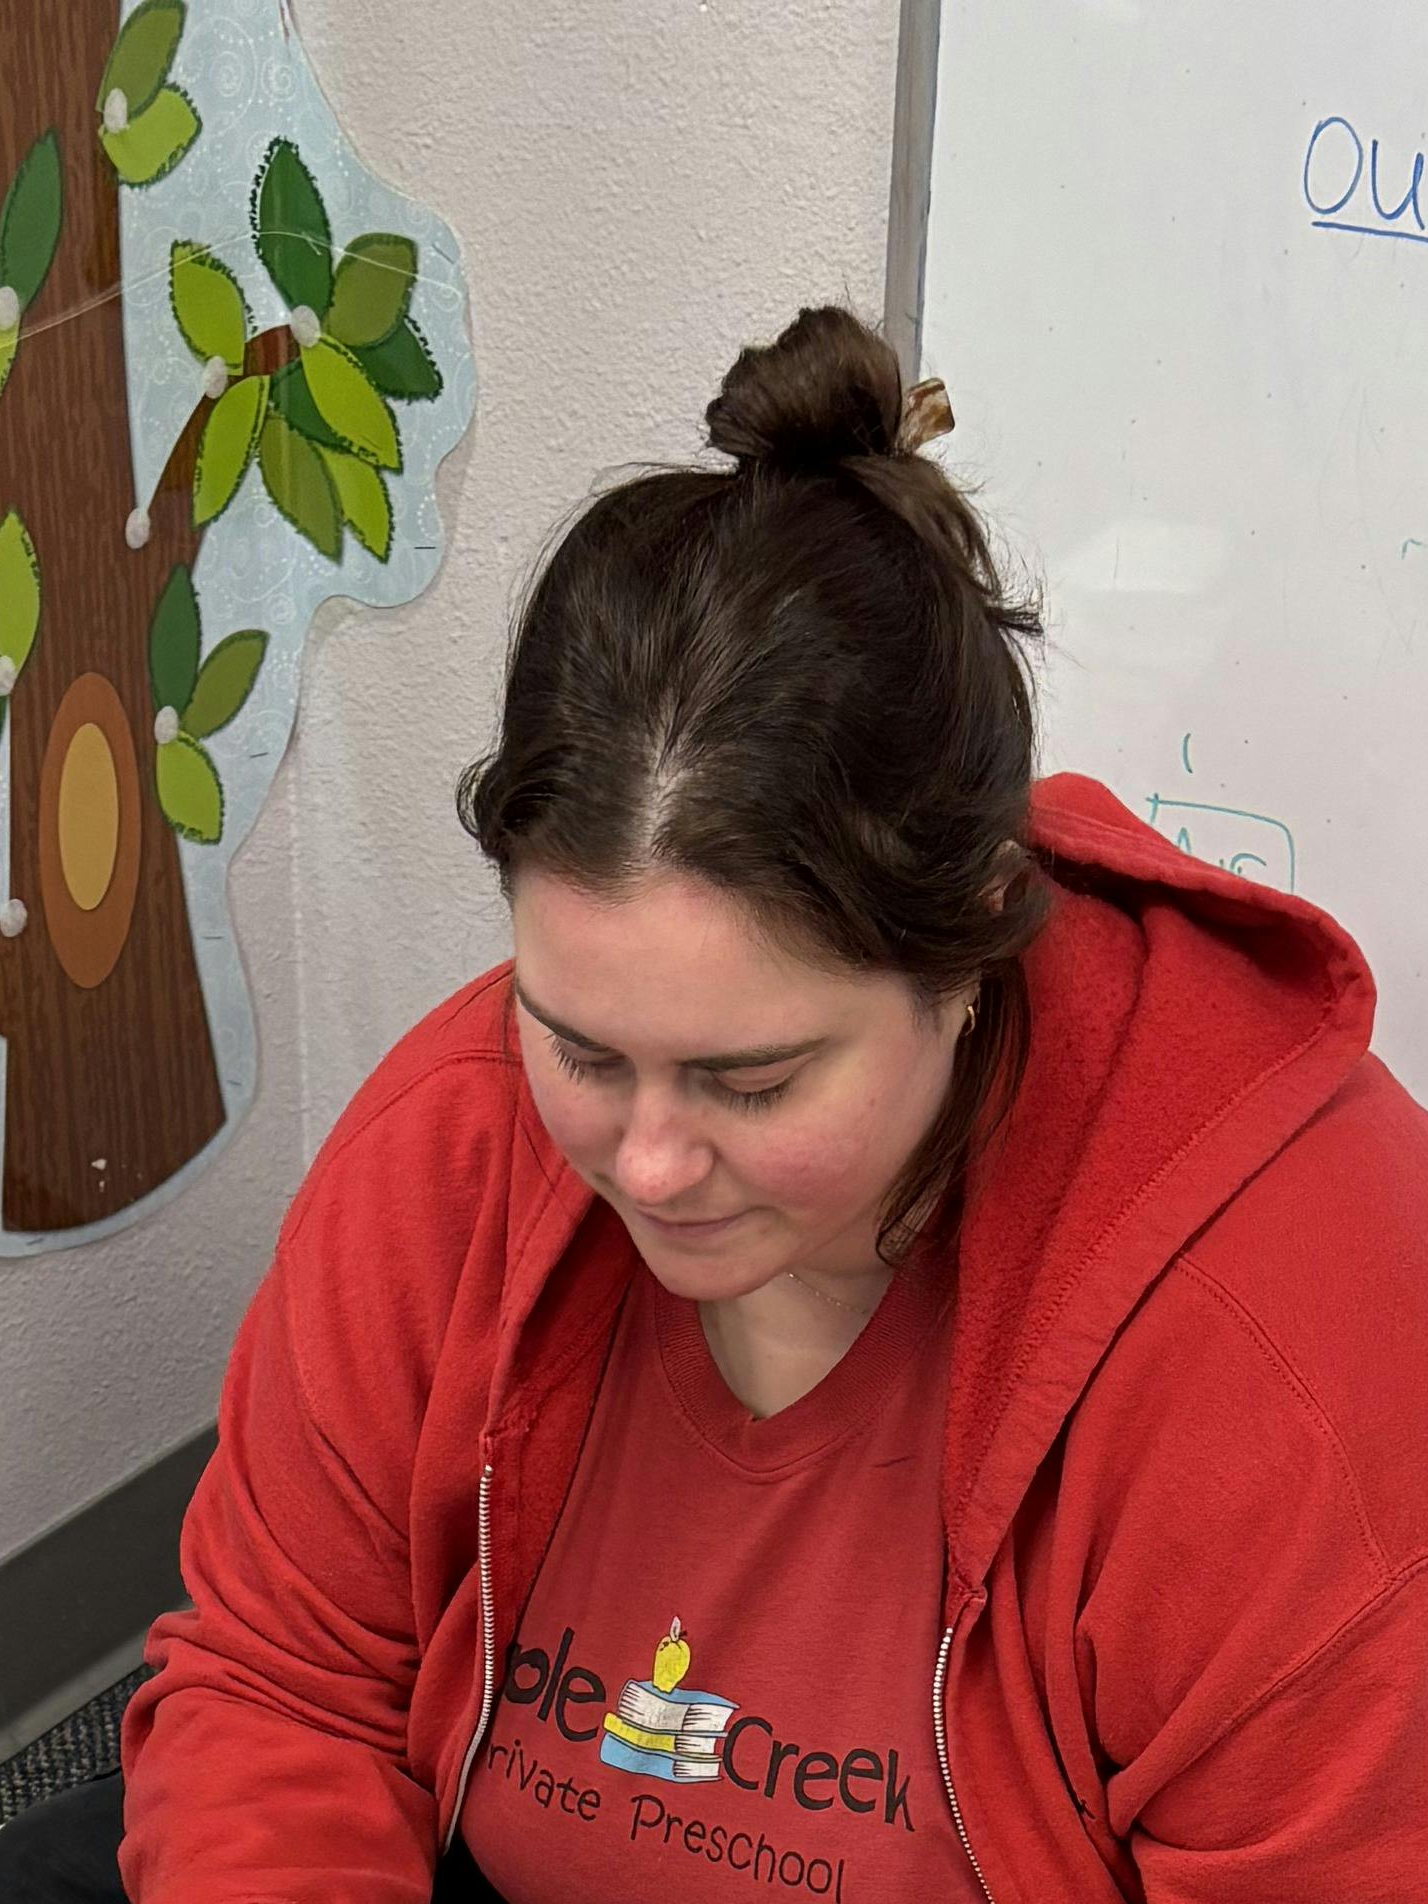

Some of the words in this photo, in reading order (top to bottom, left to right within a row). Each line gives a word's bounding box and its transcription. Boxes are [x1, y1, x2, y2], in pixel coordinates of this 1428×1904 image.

[487, 1740, 602, 1822] rivate
[630, 1793, 845, 1904] Preschool
[502, 1627, 607, 1742] ple
[721, 1716, 916, 1833] Creek
